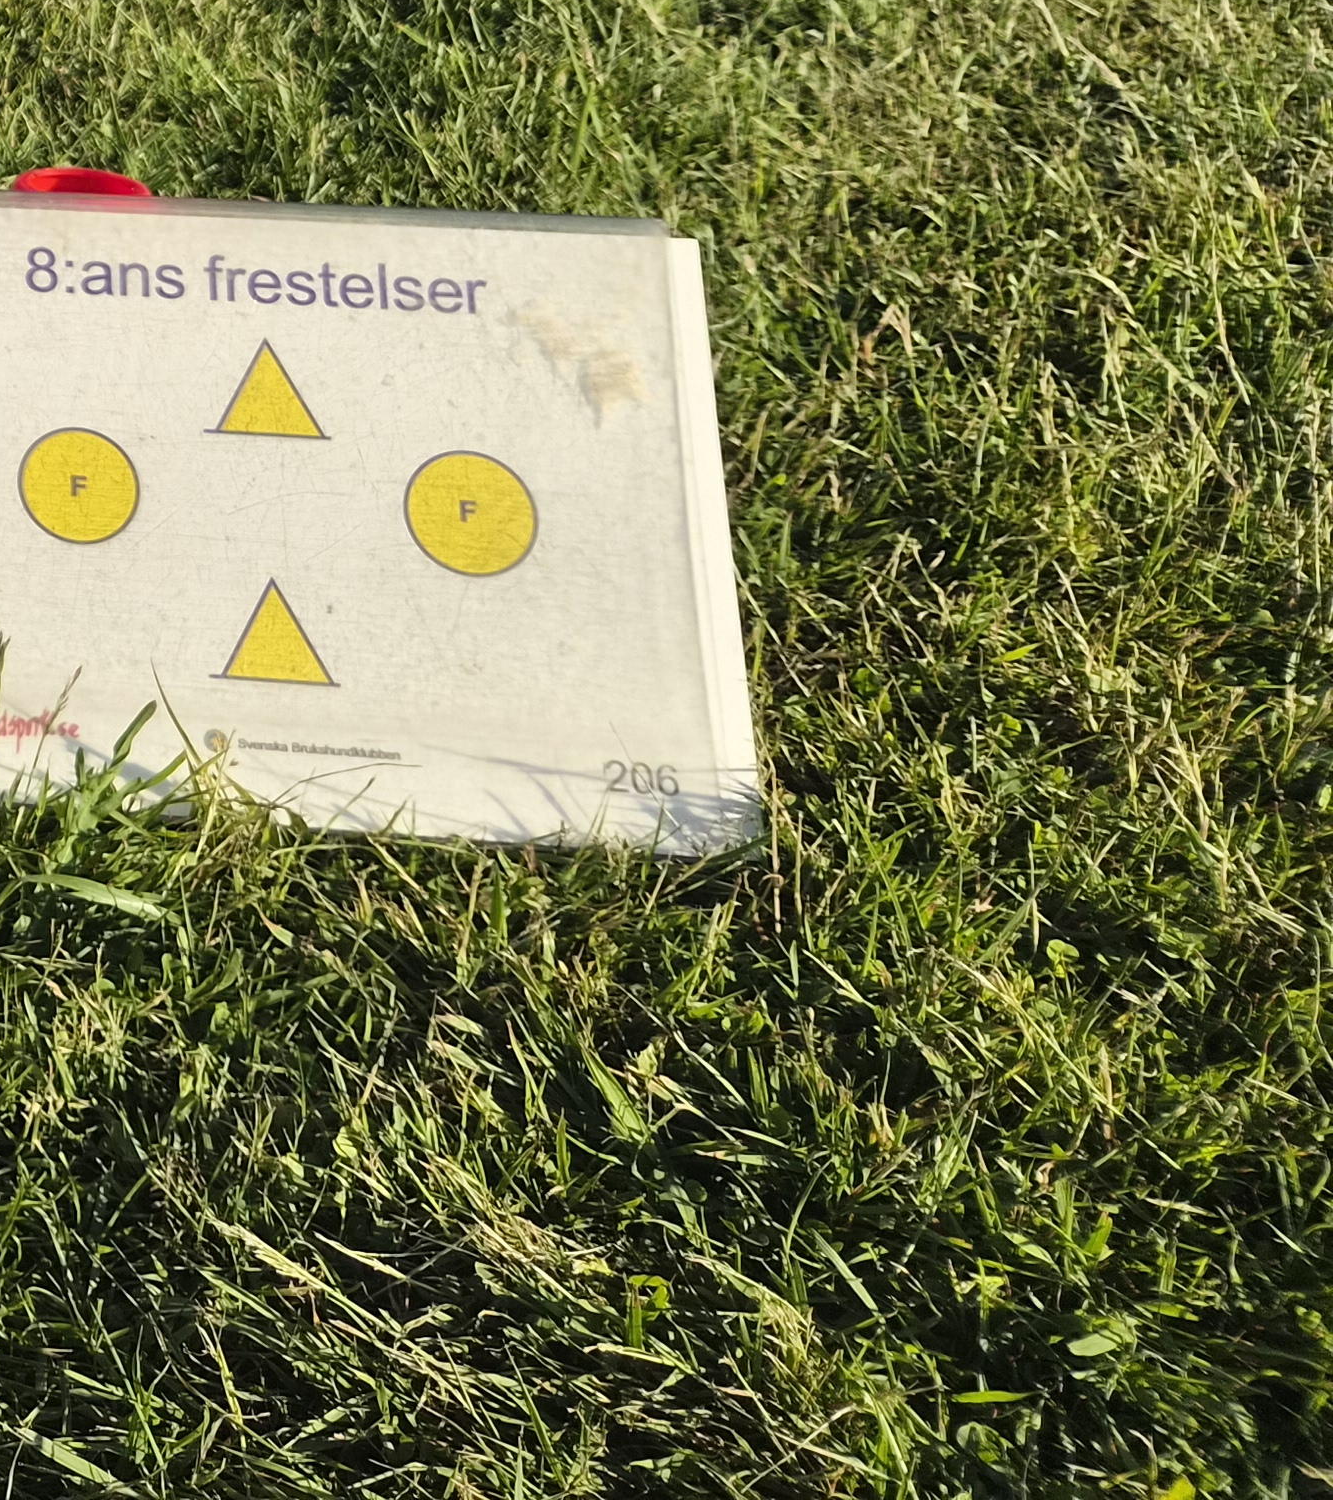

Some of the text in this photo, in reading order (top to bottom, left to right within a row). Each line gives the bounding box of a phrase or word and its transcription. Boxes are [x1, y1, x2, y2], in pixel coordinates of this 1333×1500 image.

[24, 246, 487, 314] 8:ans frestelser
[70, 474, 88, 497] F
[459, 499, 477, 523] F
[238, 738, 288, 753] Svenska
[603, 760, 679, 796] 206
